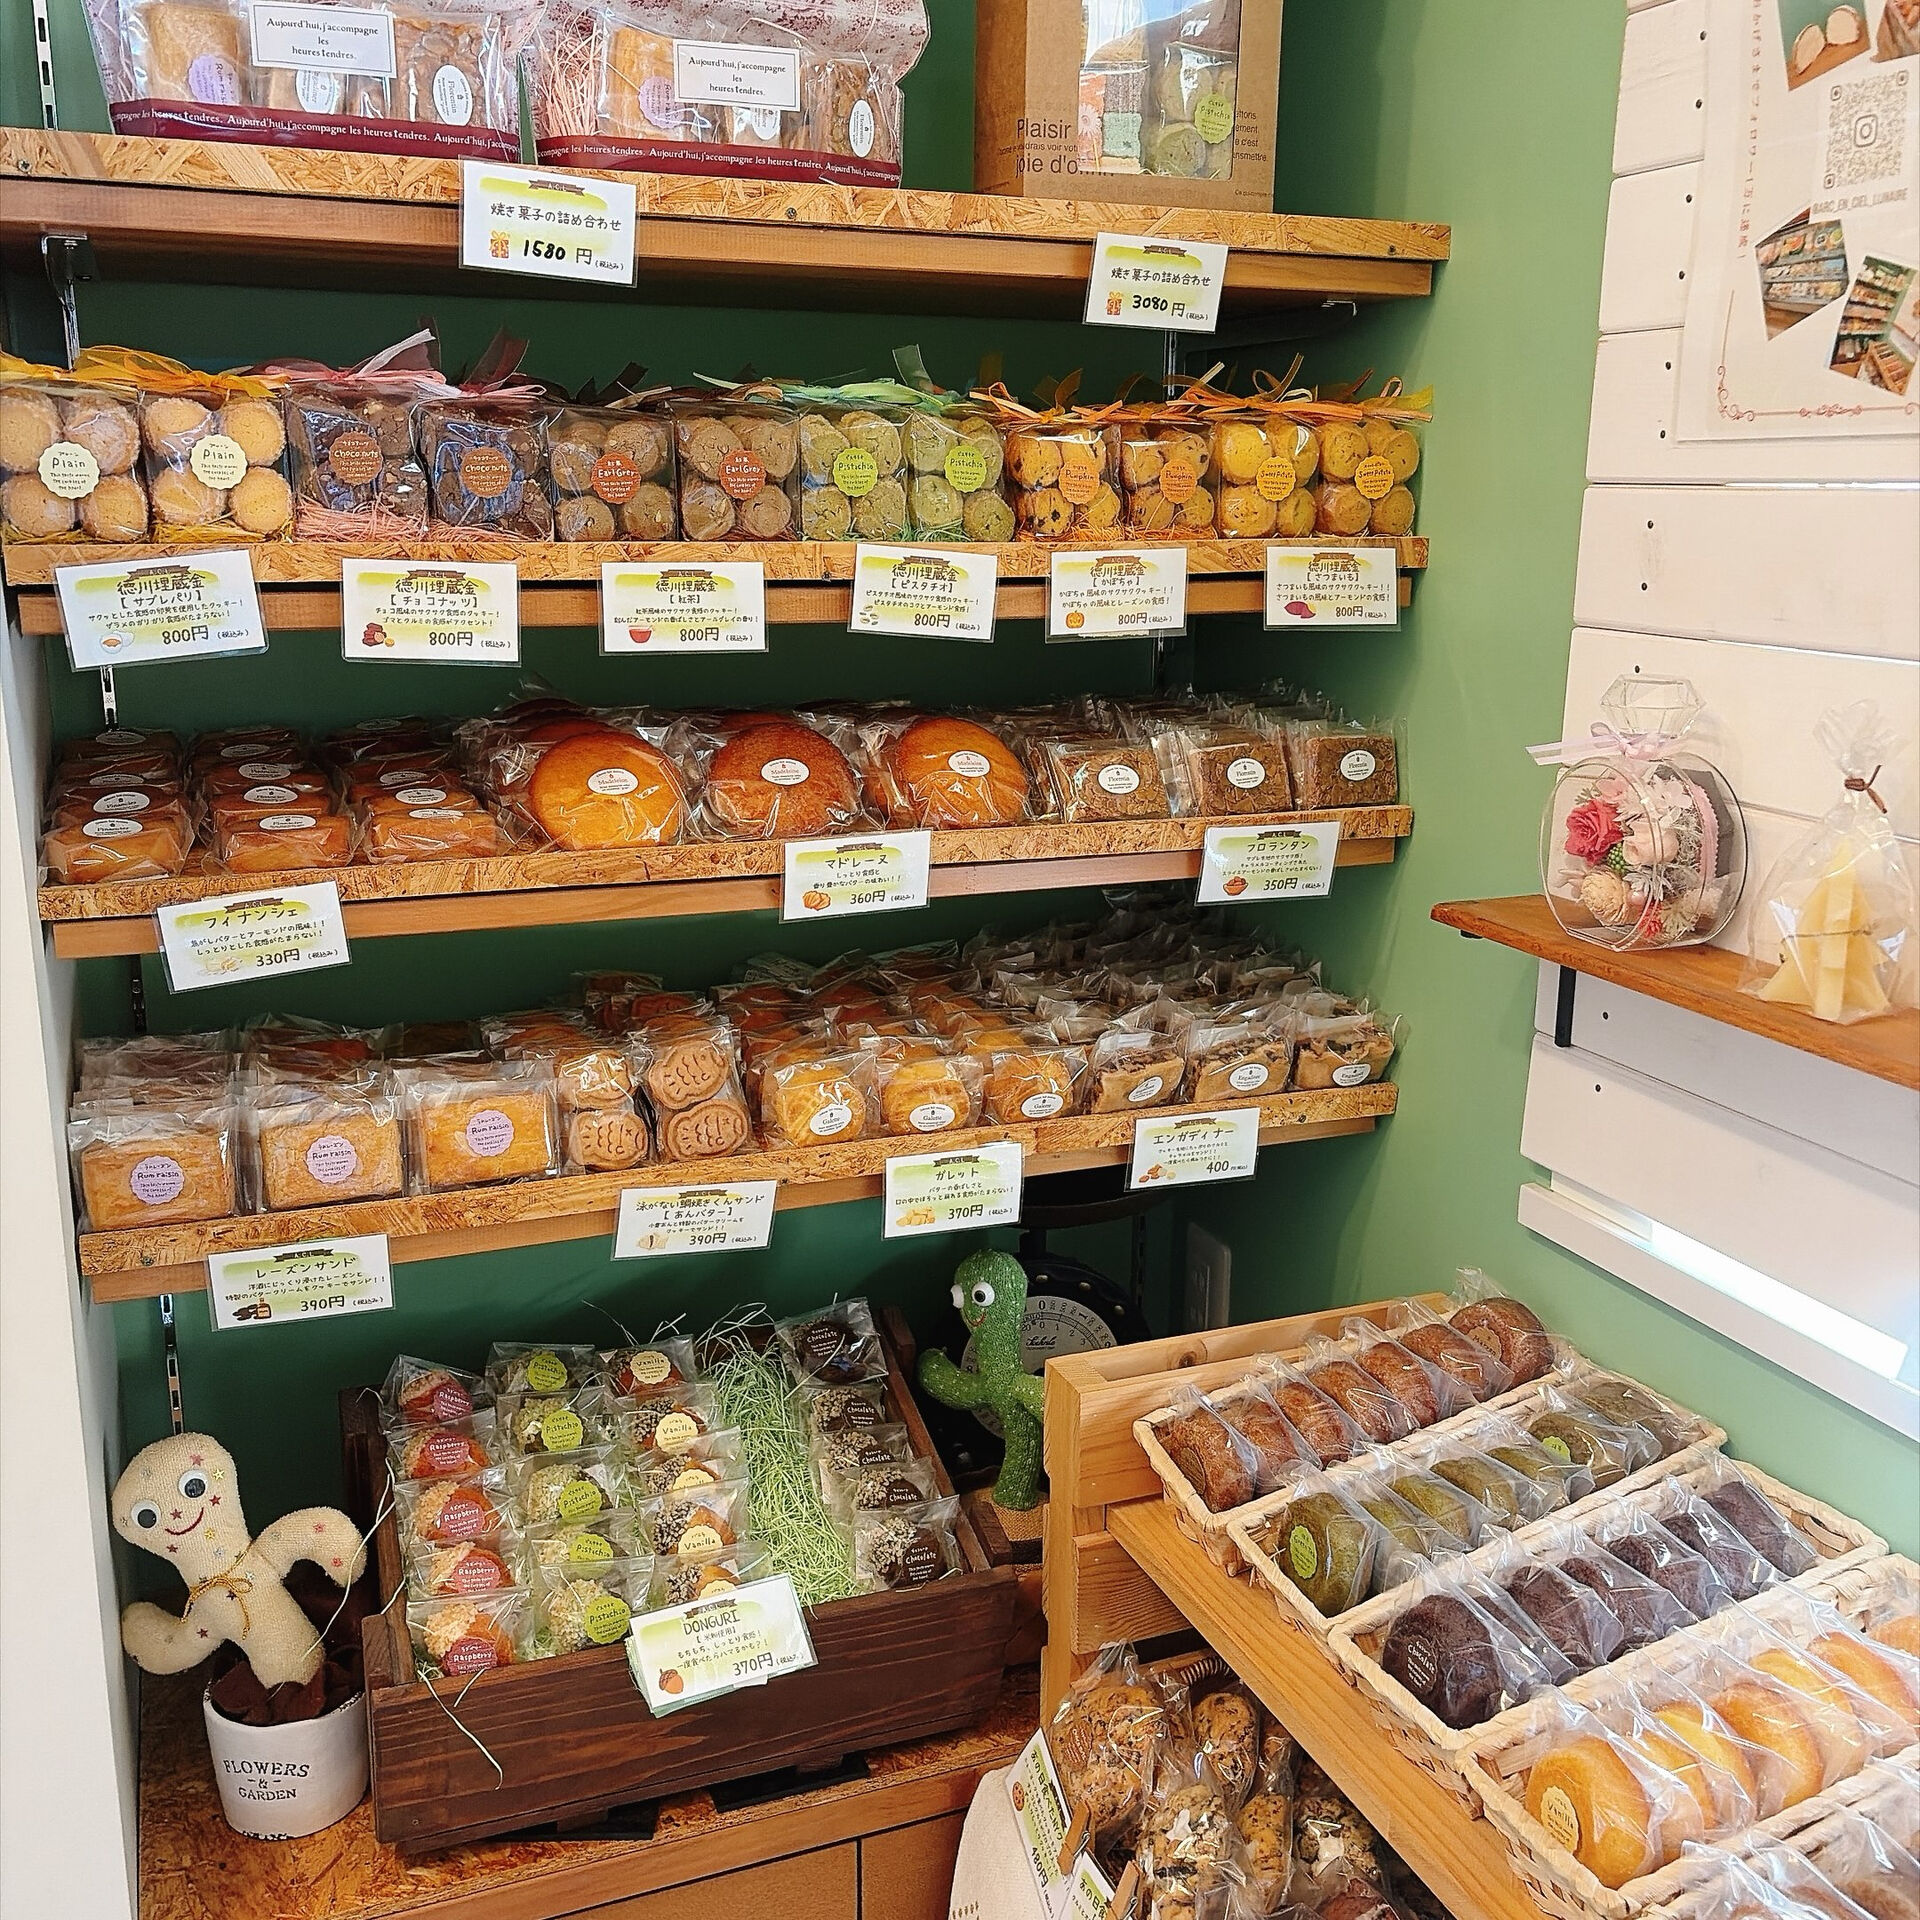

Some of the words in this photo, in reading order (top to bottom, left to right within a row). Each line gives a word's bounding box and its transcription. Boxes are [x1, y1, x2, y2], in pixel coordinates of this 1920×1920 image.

[317, 37, 329, 46] les
[292, 46, 321, 57] heures
[732, 75, 743, 84] les
[709, 83, 735, 94] heures
[349, 126, 361, 135] les
[363, 127, 393, 139] heures
[1017, 119, 1072, 145] Plaisir
[1046, 143, 1062, 152] voir
[571, 144, 581, 153] les
[583, 145, 611, 156] heures
[756, 154, 766, 164] les
[767, 157, 793, 167] heures
[490, 201, 622, 232] 焼き菓子の詰め合わせ
[523, 239, 566, 261] 1580
[576, 247, 593, 265] 円
[1111, 266, 1211, 287] 焼き菓子の詰め合わせ
[1132, 295, 1168, 312] 3080
[1171, 302, 1185, 317] 円
[203, 448, 234, 460] Plain
[362, 450, 379, 459] nuts
[52, 457, 86, 470] Plain
[492, 465, 508, 473] nuts
[726, 465, 743, 475] Earl
[743, 465, 761, 474] Grey
[838, 462, 874, 472] Pistachio
[950, 458, 983, 468] Pistachio
[598, 469, 615, 479] Earl
[616, 468, 635, 478] Grey
[1065, 469, 1095, 481] Pumpkin
[892, 563, 960, 582] 徳川埋蔵金
[1090, 564, 1147, 578] 徳川埋蔵金
[116, 573, 206, 596] 徳川埋蔵金
[396, 578, 479, 596] 徳川埋蔵金
[656, 579, 719, 594] 徳川埋蔵金
[1118, 612, 1148, 625] 800円
[1335, 606, 1363, 617] 800円
[914, 612, 951, 629] 800円
[162, 625, 209, 645] 800円
[429, 631, 474, 647] 800円
[680, 627, 719, 642] 800円
[1248, 841, 1311, 853] フロランタン
[825, 855, 889, 870] マドレーヌ
[1263, 878, 1298, 892] 350円
[850, 890, 885, 906] 360円
[204, 908, 299, 929] フィナンシェ
[256, 948, 300, 968] 330円
[471, 1127, 488, 1136] Rum
[488, 1123, 510, 1132] raisin
[1153, 1128, 1235, 1146] エンガディナー
[312, 1152, 329, 1161] Rum
[330, 1150, 351, 1158] raisin
[935, 1168, 980, 1181] ガレット
[1206, 1161, 1230, 1175] 400
[137, 1173, 155, 1181] Rum
[636, 1195, 765, 1212] 泳がない鯛焼きくんサンド
[948, 1204, 984, 1221] 370円
[689, 1233, 727, 1246] 390円
[256, 1258, 357, 1279] レーズンサンド
[300, 1294, 345, 1313] 390円
[636, 1358, 665, 1367] Vanilla
[439, 1391, 470, 1407] Raspberry
[847, 1406, 875, 1415] Chocolate
[546, 1421, 579, 1434] Pistachio
[662, 1424, 693, 1434] Vanilla
[429, 1442, 465, 1452] Raspberry
[862, 1454, 891, 1465] Chocolate
[563, 1490, 597, 1508] Pistachio
[889, 1492, 918, 1502] Chocolate
[444, 1508, 480, 1523] Raspberry
[576, 1544, 611, 1558] Pistachio
[684, 1538, 717, 1552] Vanilla
[906, 1551, 937, 1565] Chocolate
[458, 1568, 496, 1577] Raspberry
[590, 1608, 626, 1625] Pistachio
[683, 1610, 741, 1637] DONGURI
[453, 1651, 492, 1663] Raspberry
[732, 1652, 775, 1678] 370円
[223, 1759, 310, 1778] FLOWERS
[238, 1787, 298, 1802] GARDEN
[1030, 1847, 1050, 1888] 480円
